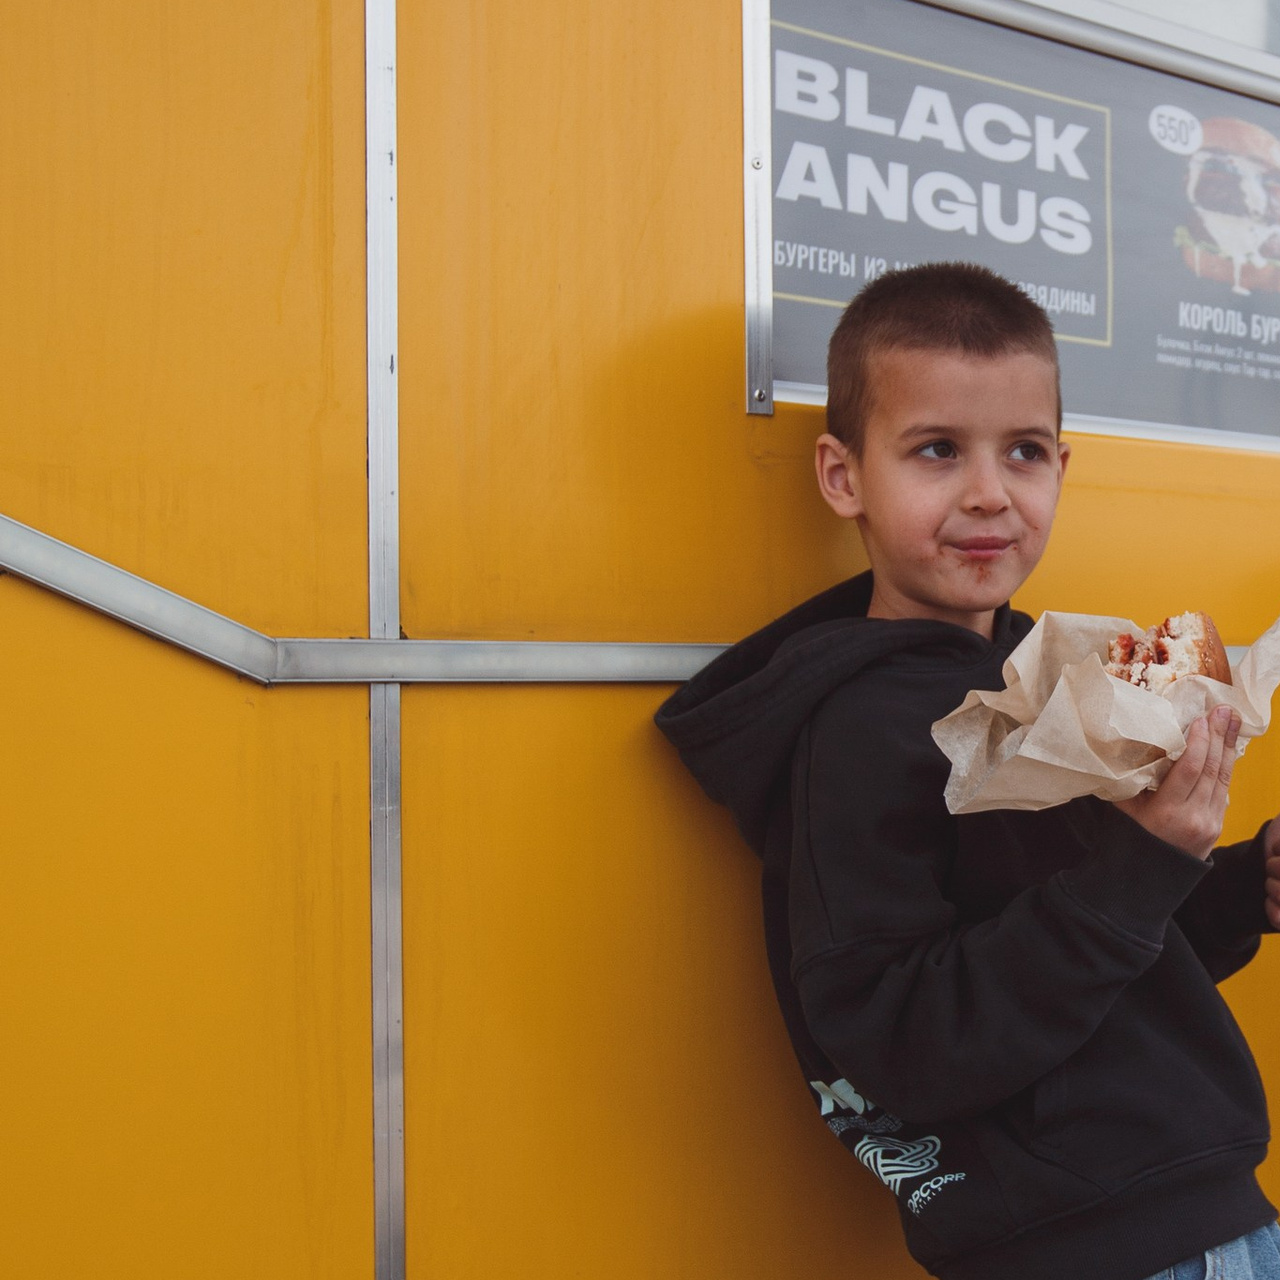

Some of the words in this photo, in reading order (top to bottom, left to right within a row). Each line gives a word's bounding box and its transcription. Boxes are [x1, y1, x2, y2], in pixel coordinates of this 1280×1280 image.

[774, 48, 1090, 180] BLACK
[775, 140, 1093, 255] ANGUS
[774, 239, 856, 278] БУРГЕРЫ
[864, 255, 887, 280] ИЗ
[1008, 280, 1096, 316] ВЯДИНЫ
[1178, 301, 1248, 338] КОРОЛЬ
